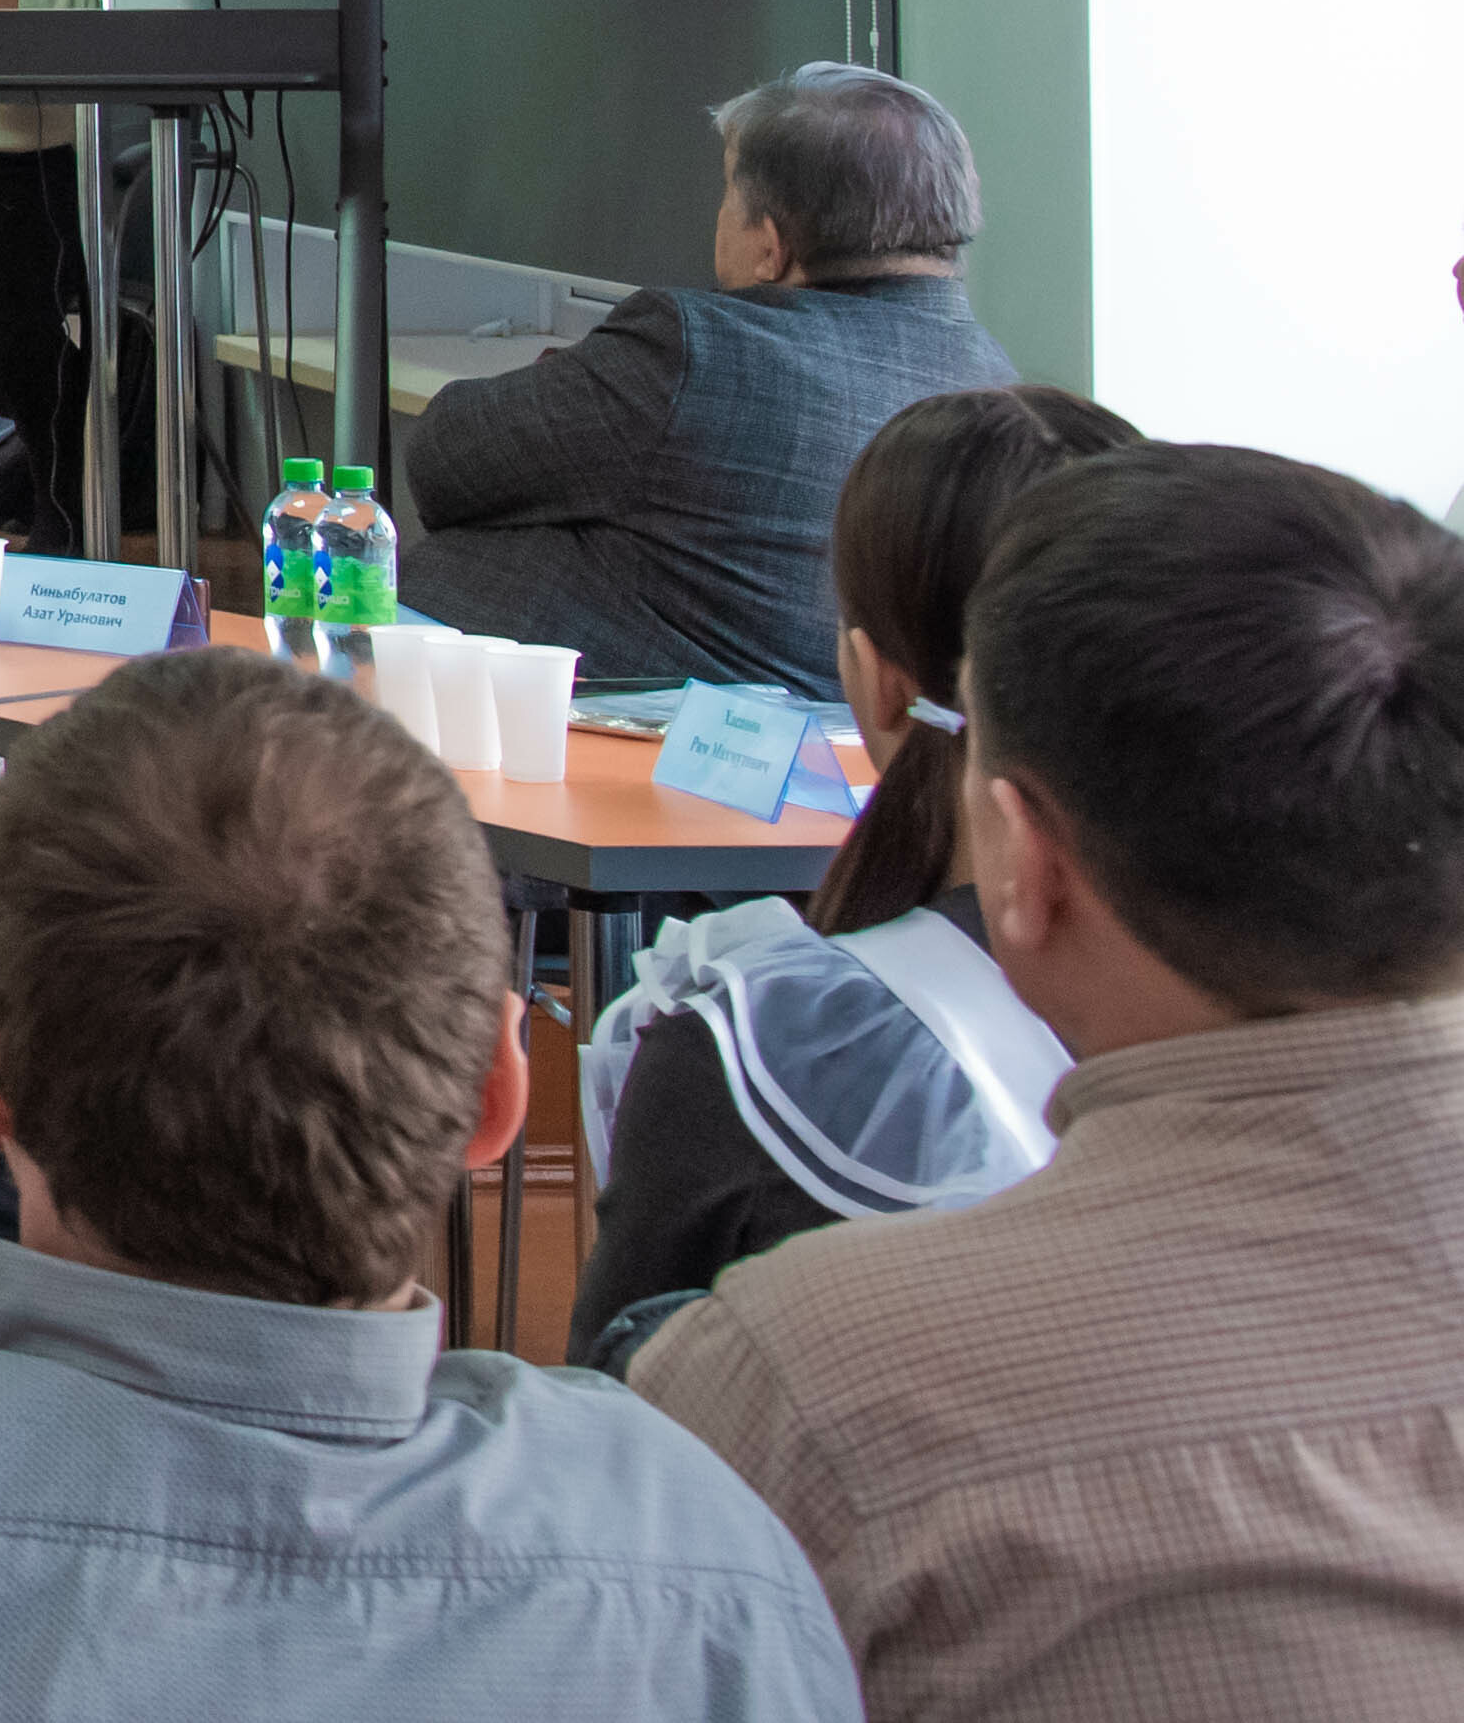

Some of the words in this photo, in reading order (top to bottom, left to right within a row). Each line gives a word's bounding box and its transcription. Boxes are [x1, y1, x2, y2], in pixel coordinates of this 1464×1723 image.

[30, 583, 127, 605] Киньябулатов
[22, 604, 55, 620] Азат
[56, 608, 123, 628] Уранович
